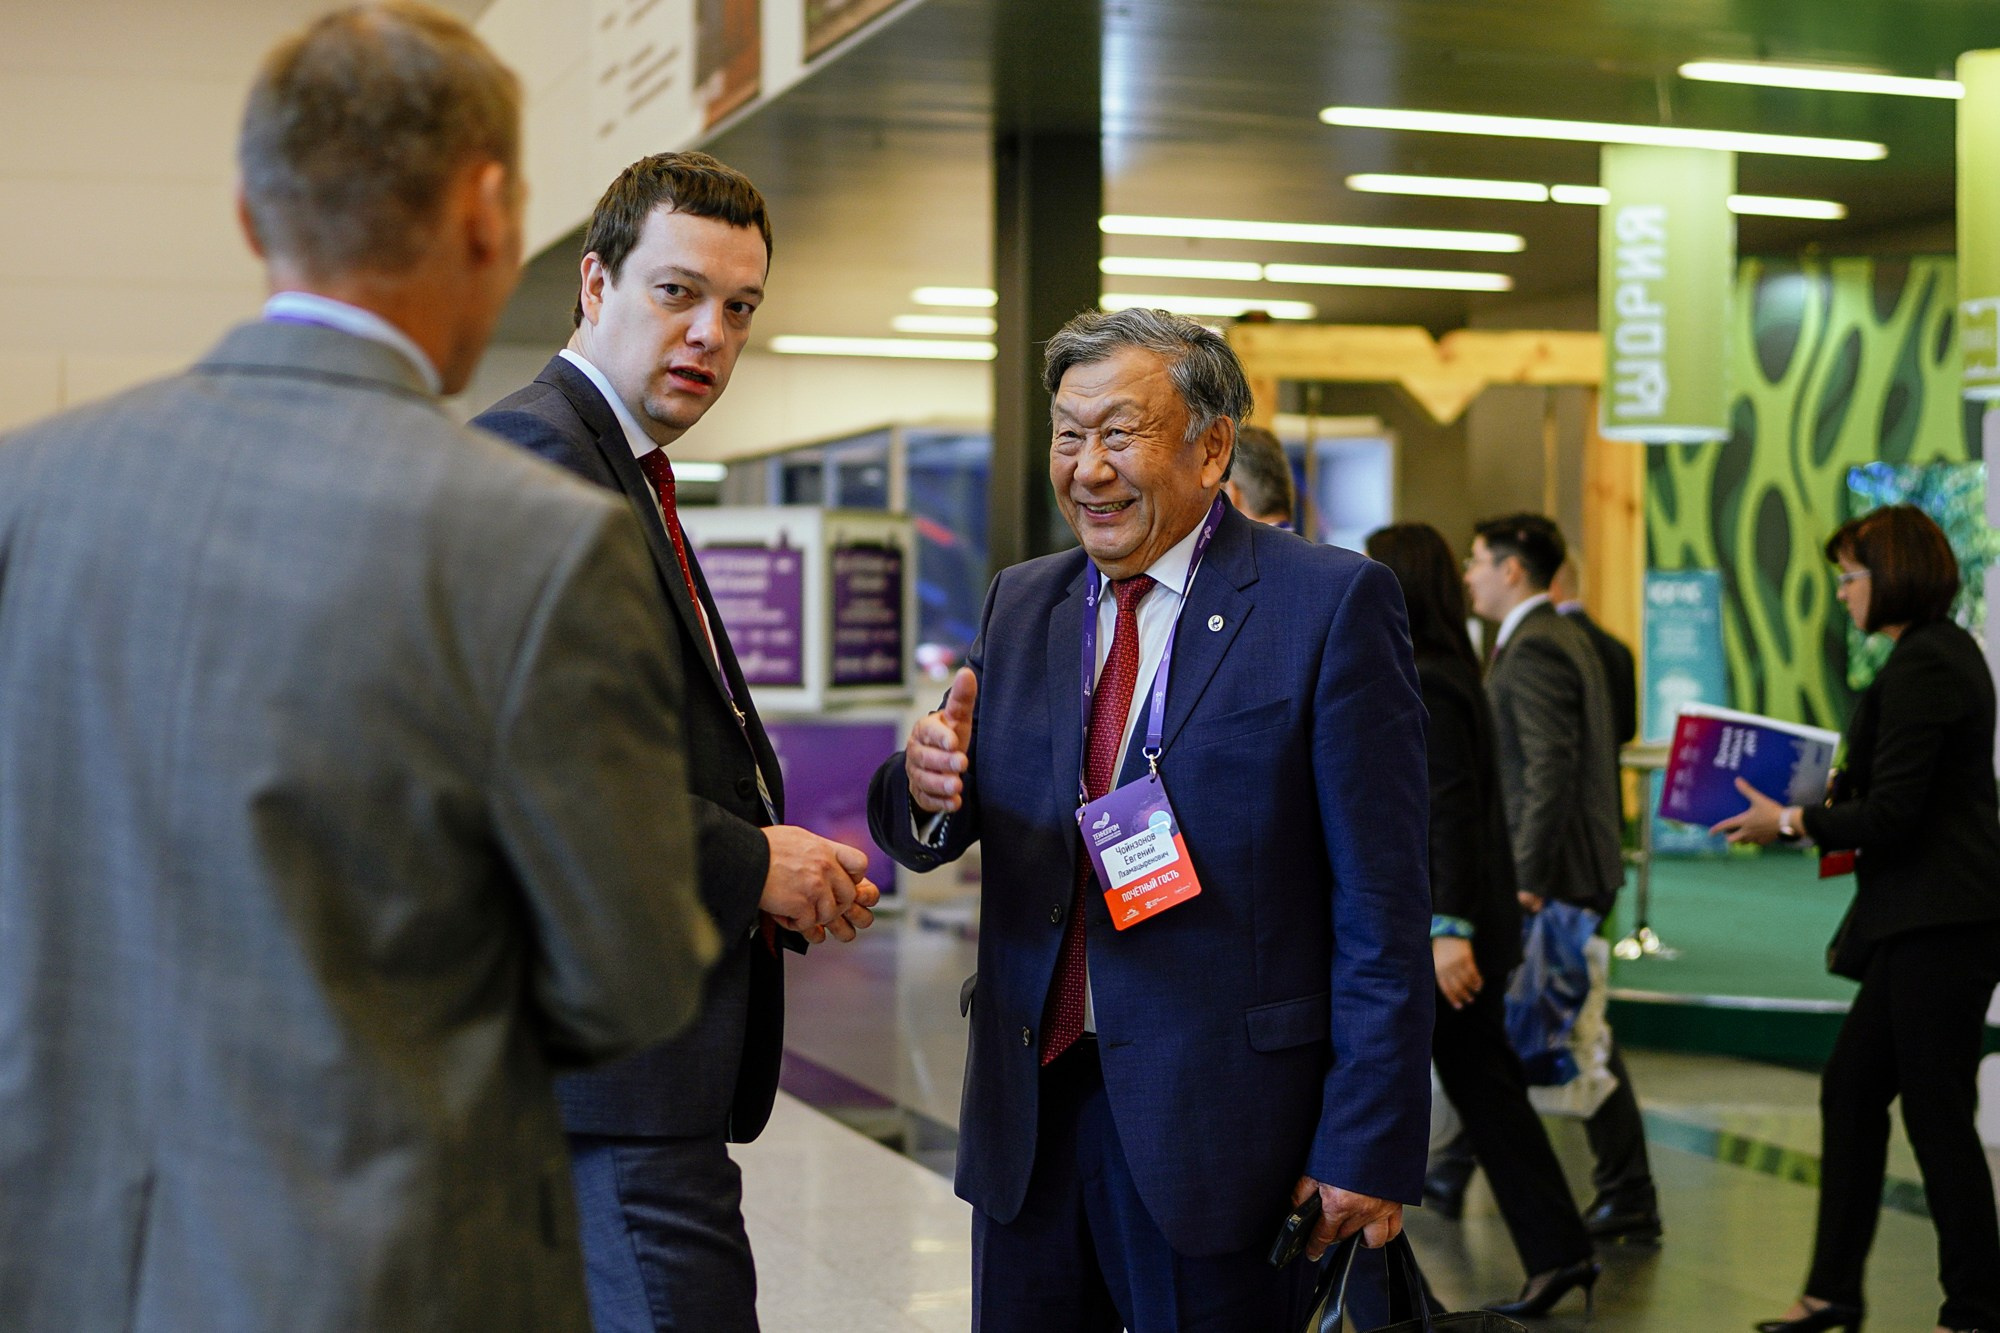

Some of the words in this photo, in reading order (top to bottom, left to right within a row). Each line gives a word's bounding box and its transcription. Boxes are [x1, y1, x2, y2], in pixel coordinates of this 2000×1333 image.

[1613, 204, 1667, 418] ШОРИЯ
[1115, 832, 1156, 856] Чойнзонов
[1124, 844, 1156, 866] Евгений
[1118, 850, 1169, 879] Лхамацыренович
[1157, 869, 1180, 888] ГОСТЬ
